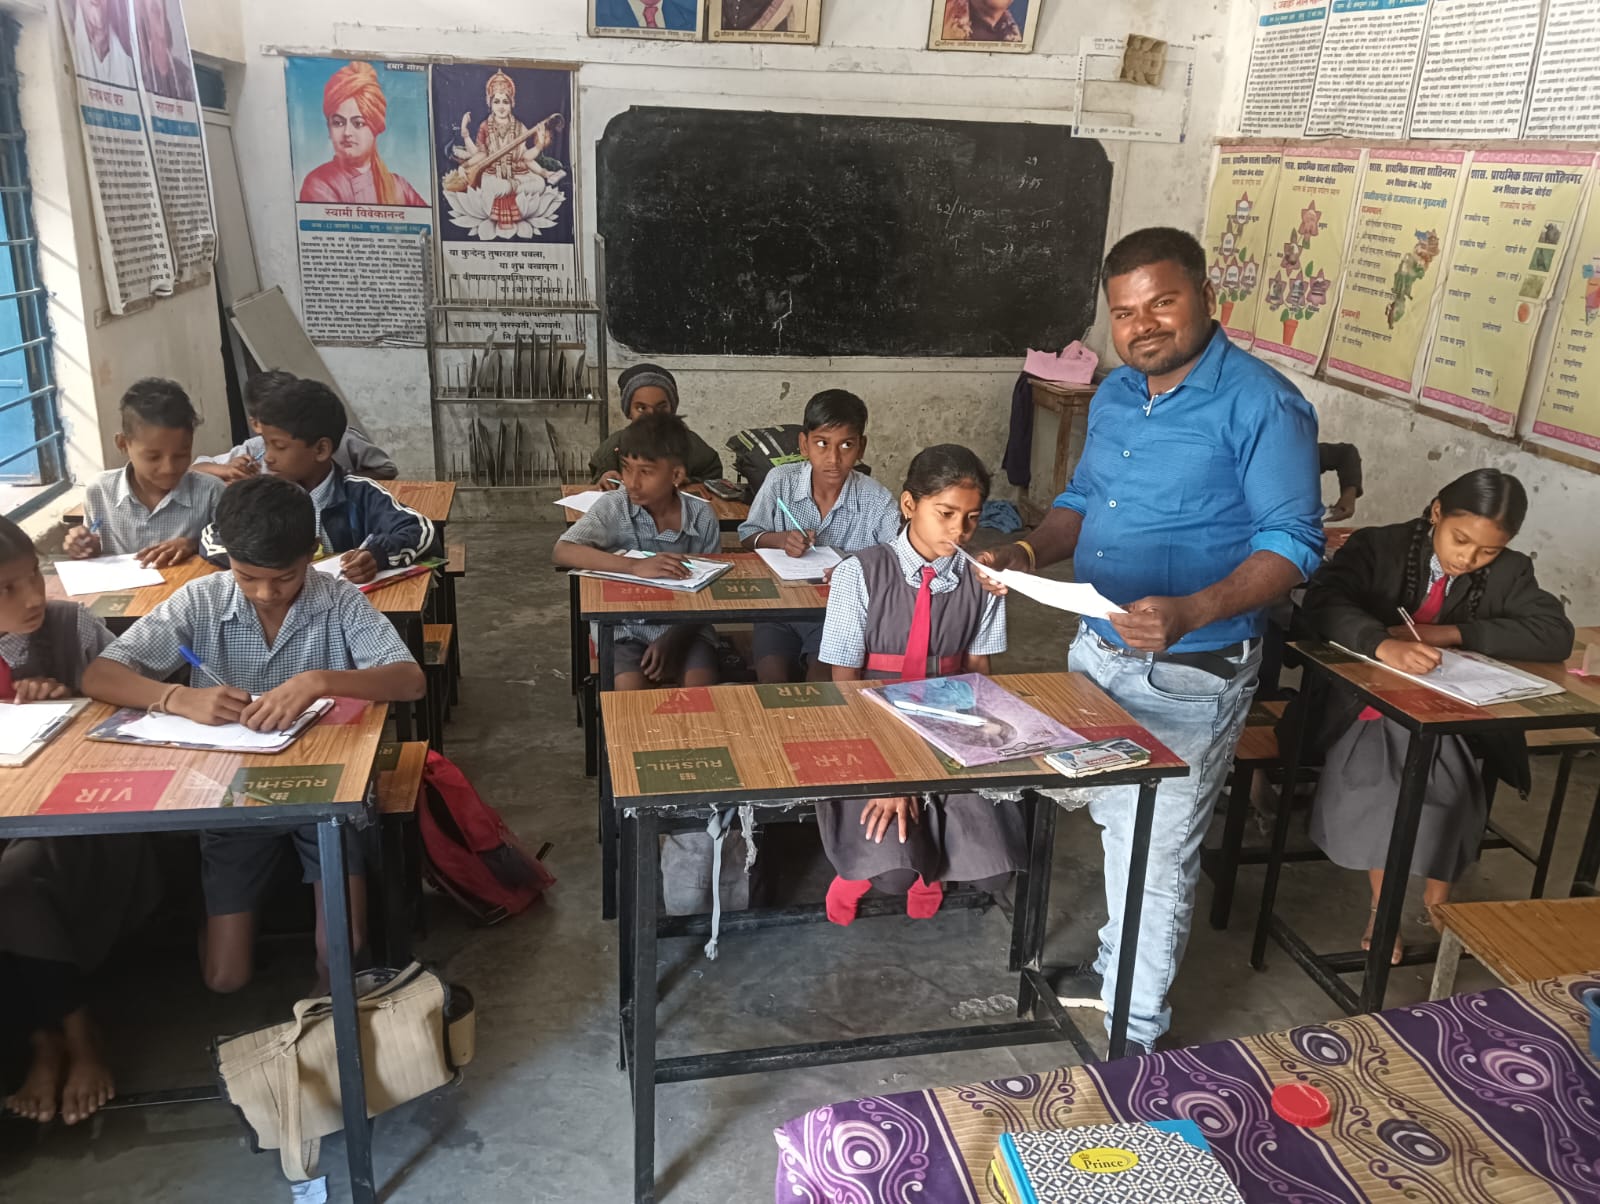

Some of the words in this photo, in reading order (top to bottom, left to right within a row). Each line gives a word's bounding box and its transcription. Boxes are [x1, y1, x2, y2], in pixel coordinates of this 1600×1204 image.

[1385, 162, 1409, 175] प्राथमिक
[1409, 166, 1426, 176] शाला
[1471, 168, 1488, 180] शास.
[1490, 168, 1521, 182] प्राथमिक
[1522, 171, 1543, 183] शाला
[325, 206, 352, 217] स्वामी
[357, 206, 405, 219] विवेकानन्द
[449, 249, 459, 257] या
[488, 250, 518, 260] तुषारहार
[499, 262, 508, 270] या
[511, 262, 525, 272] शुभ्र
[483, 322, 497, 331] पातु
[727, 584, 761, 593] VIR
[778, 686, 820, 697] VIR
[647, 759, 723, 772] RUSHIL
[75, 786, 133, 803] VIR
[1083, 1158, 1123, 1170] Prince
